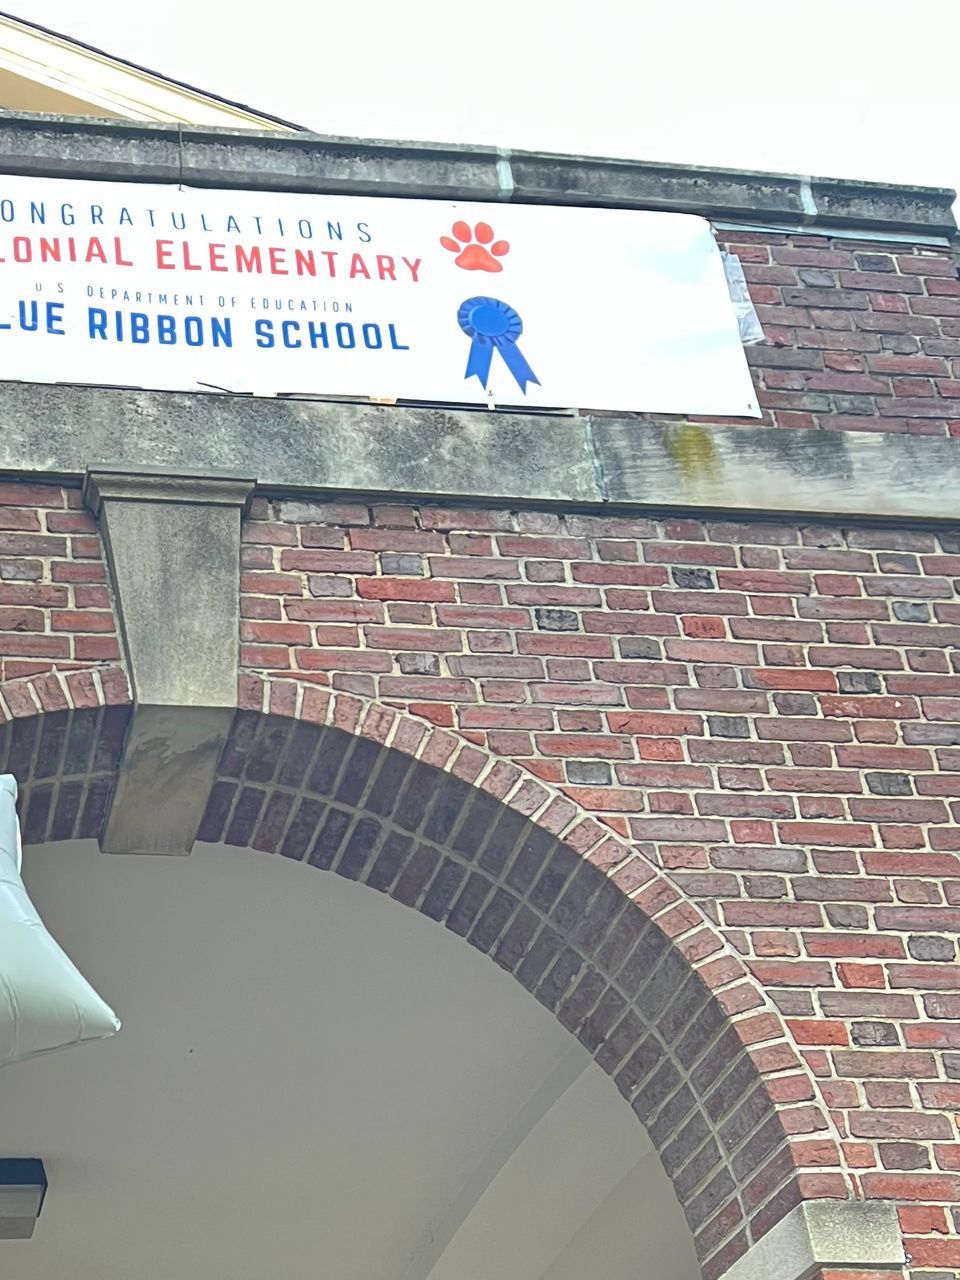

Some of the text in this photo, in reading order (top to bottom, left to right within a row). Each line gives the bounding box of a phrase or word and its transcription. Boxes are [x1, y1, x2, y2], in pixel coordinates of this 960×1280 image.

[156, 239, 422, 282] ELEMENTARY
[87, 285, 204, 306] DEPARTMENT
[218, 296, 237, 308] OF
[251, 298, 353, 313] EDUCATION
[88, 307, 233, 348] RIBBON
[255, 319, 410, 351] SCHOOL
